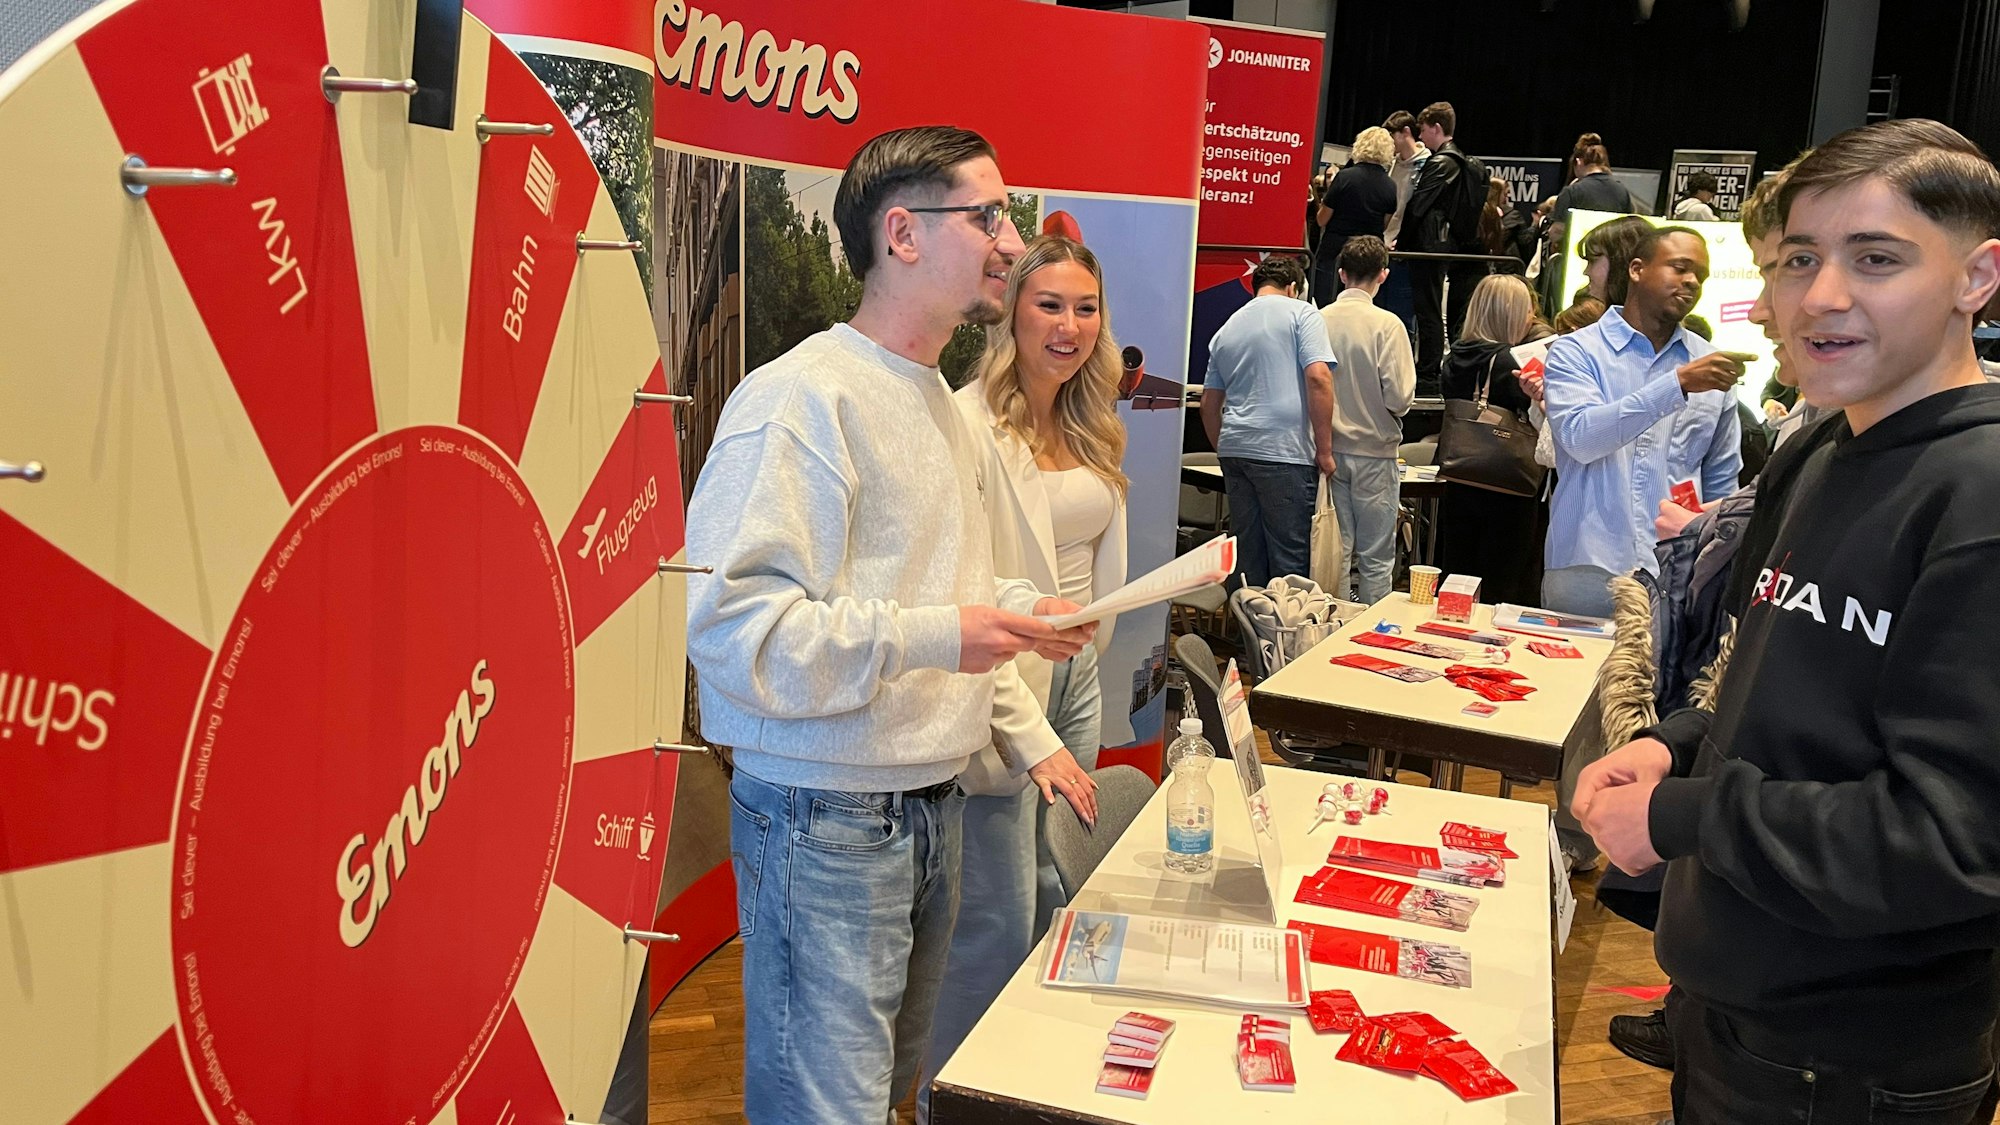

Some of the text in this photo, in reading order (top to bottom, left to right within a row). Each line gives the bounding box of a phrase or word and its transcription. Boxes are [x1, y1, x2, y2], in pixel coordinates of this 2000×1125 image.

[1227, 49, 1311, 72] JOHANNITER
[1203, 120, 1304, 147] ertschätzung,
[1202, 144, 1291, 167] genseitigen
[1200, 166, 1281, 185] espekt und
[1485, 165, 1539, 182] OMM INS
[1200, 186, 1254, 204] leranz!
[1506, 181, 1539, 203] AM
[251, 197, 308, 314] LKW
[502, 234, 538, 342] Bahn
[1713, 267, 1761, 280] usbildu
[261, 566, 278, 593] Sei
[277, 528, 302, 569] clever
[310, 471, 358, 524] Ausbildung
[357, 457, 372, 478] bei
[372, 442, 403, 468] Emons!
[597, 475, 657, 576] Flugzeug
[222, 617, 253, 680] Emons!
[212, 682, 229, 709] bei
[0, 673, 115, 751] Schi
[189, 715, 223, 811] Ausbildung
[336, 659, 496, 948] Emons
[594, 813, 635, 849] Schiff
[184, 834, 198, 887] clever
[181, 891, 195, 920] Sei
